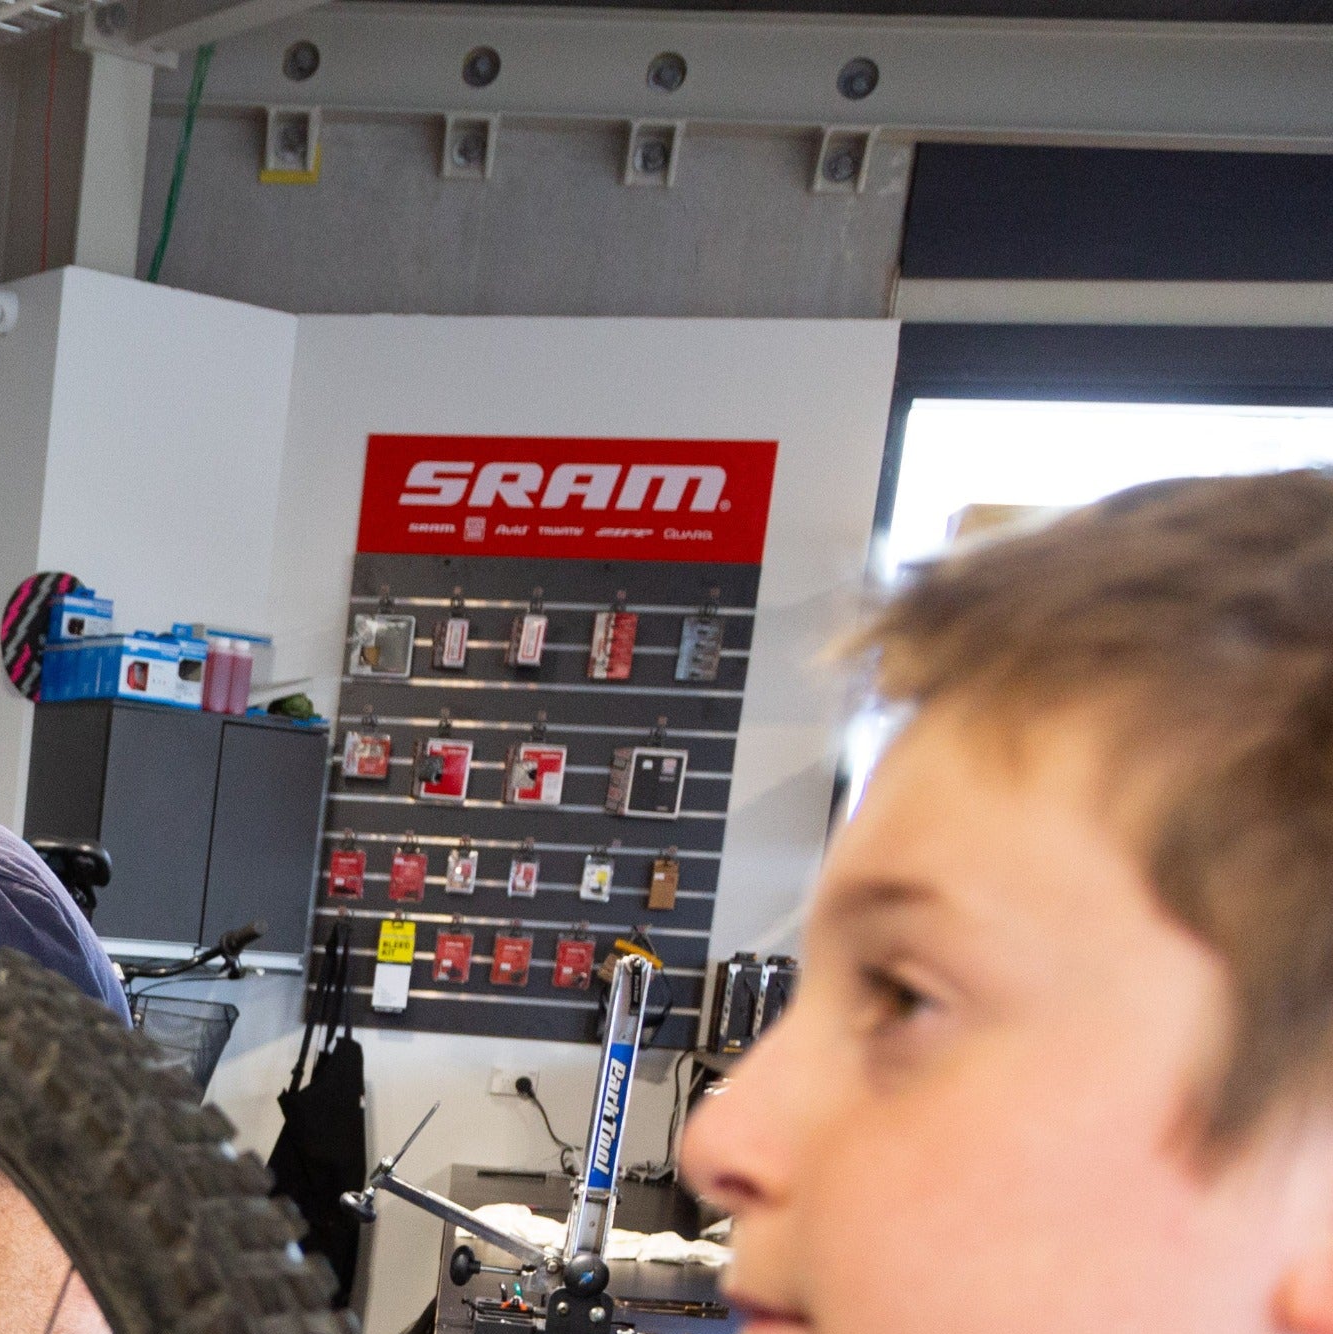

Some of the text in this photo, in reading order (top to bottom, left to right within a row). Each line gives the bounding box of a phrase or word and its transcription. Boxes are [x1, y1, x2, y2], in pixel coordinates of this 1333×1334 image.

[398, 460, 728, 513] SRAM
[594, 1057, 626, 1176] Park Tool
